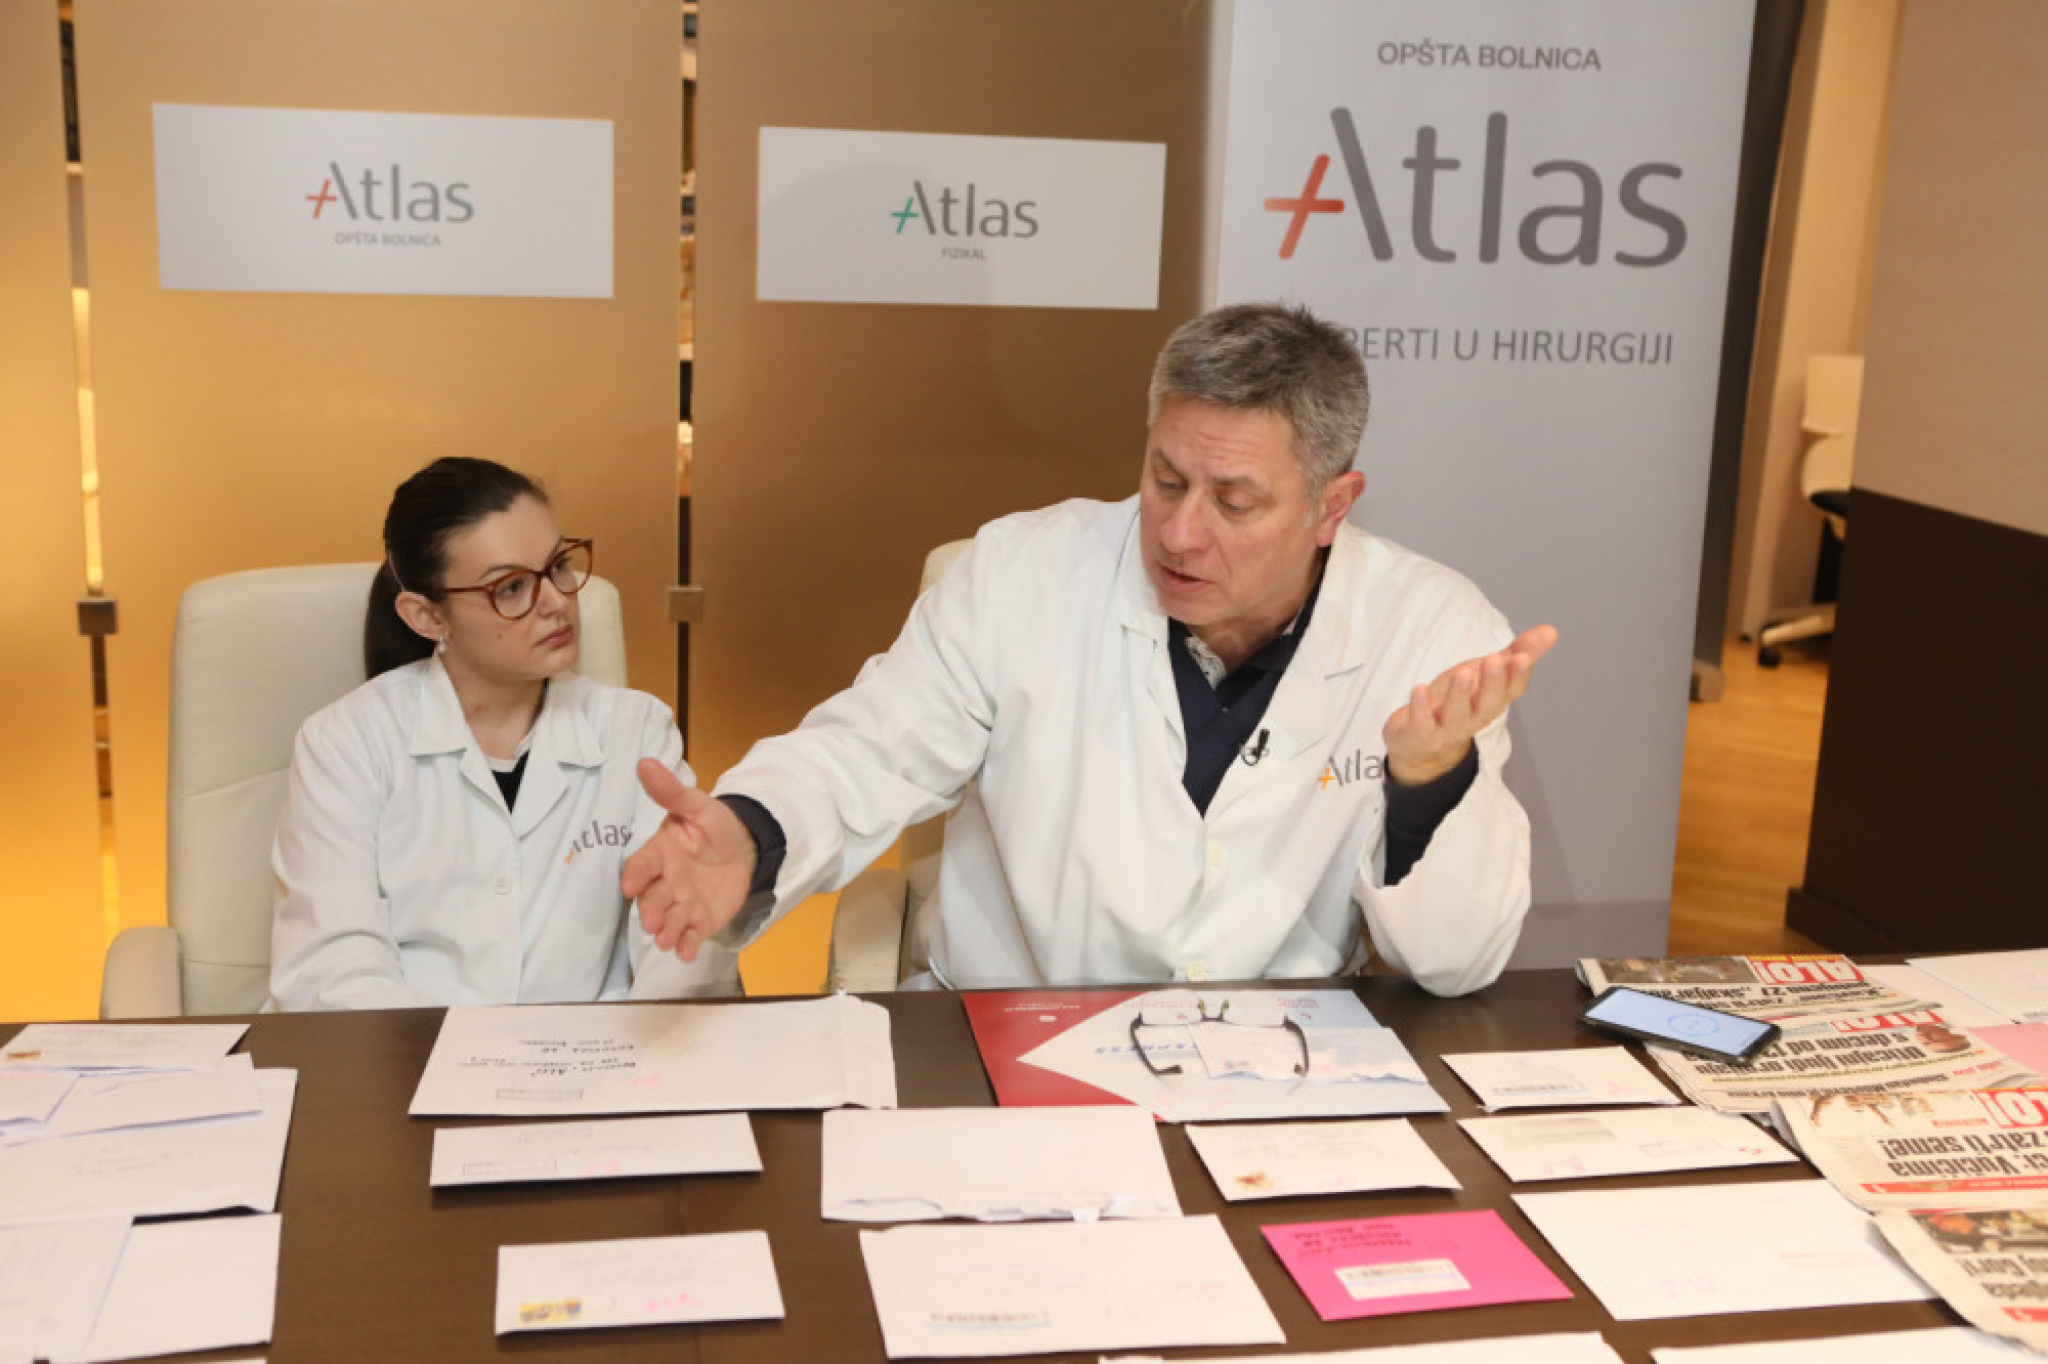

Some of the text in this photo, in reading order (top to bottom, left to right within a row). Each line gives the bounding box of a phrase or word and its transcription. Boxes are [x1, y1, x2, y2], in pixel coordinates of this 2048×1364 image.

[1377, 38, 1601, 72] OPŠTA BOLNICA
[305, 161, 475, 223] Atlas
[1263, 105, 1688, 268] Atlas
[890, 180, 1039, 239] Atlas
[334, 231, 441, 247] OPŠTA BOLNICA
[942, 247, 986, 260] FIZIKAL
[1339, 327, 1674, 365] PERTI U HIRURGIJI
[1311, 749, 1384, 792] Atla
